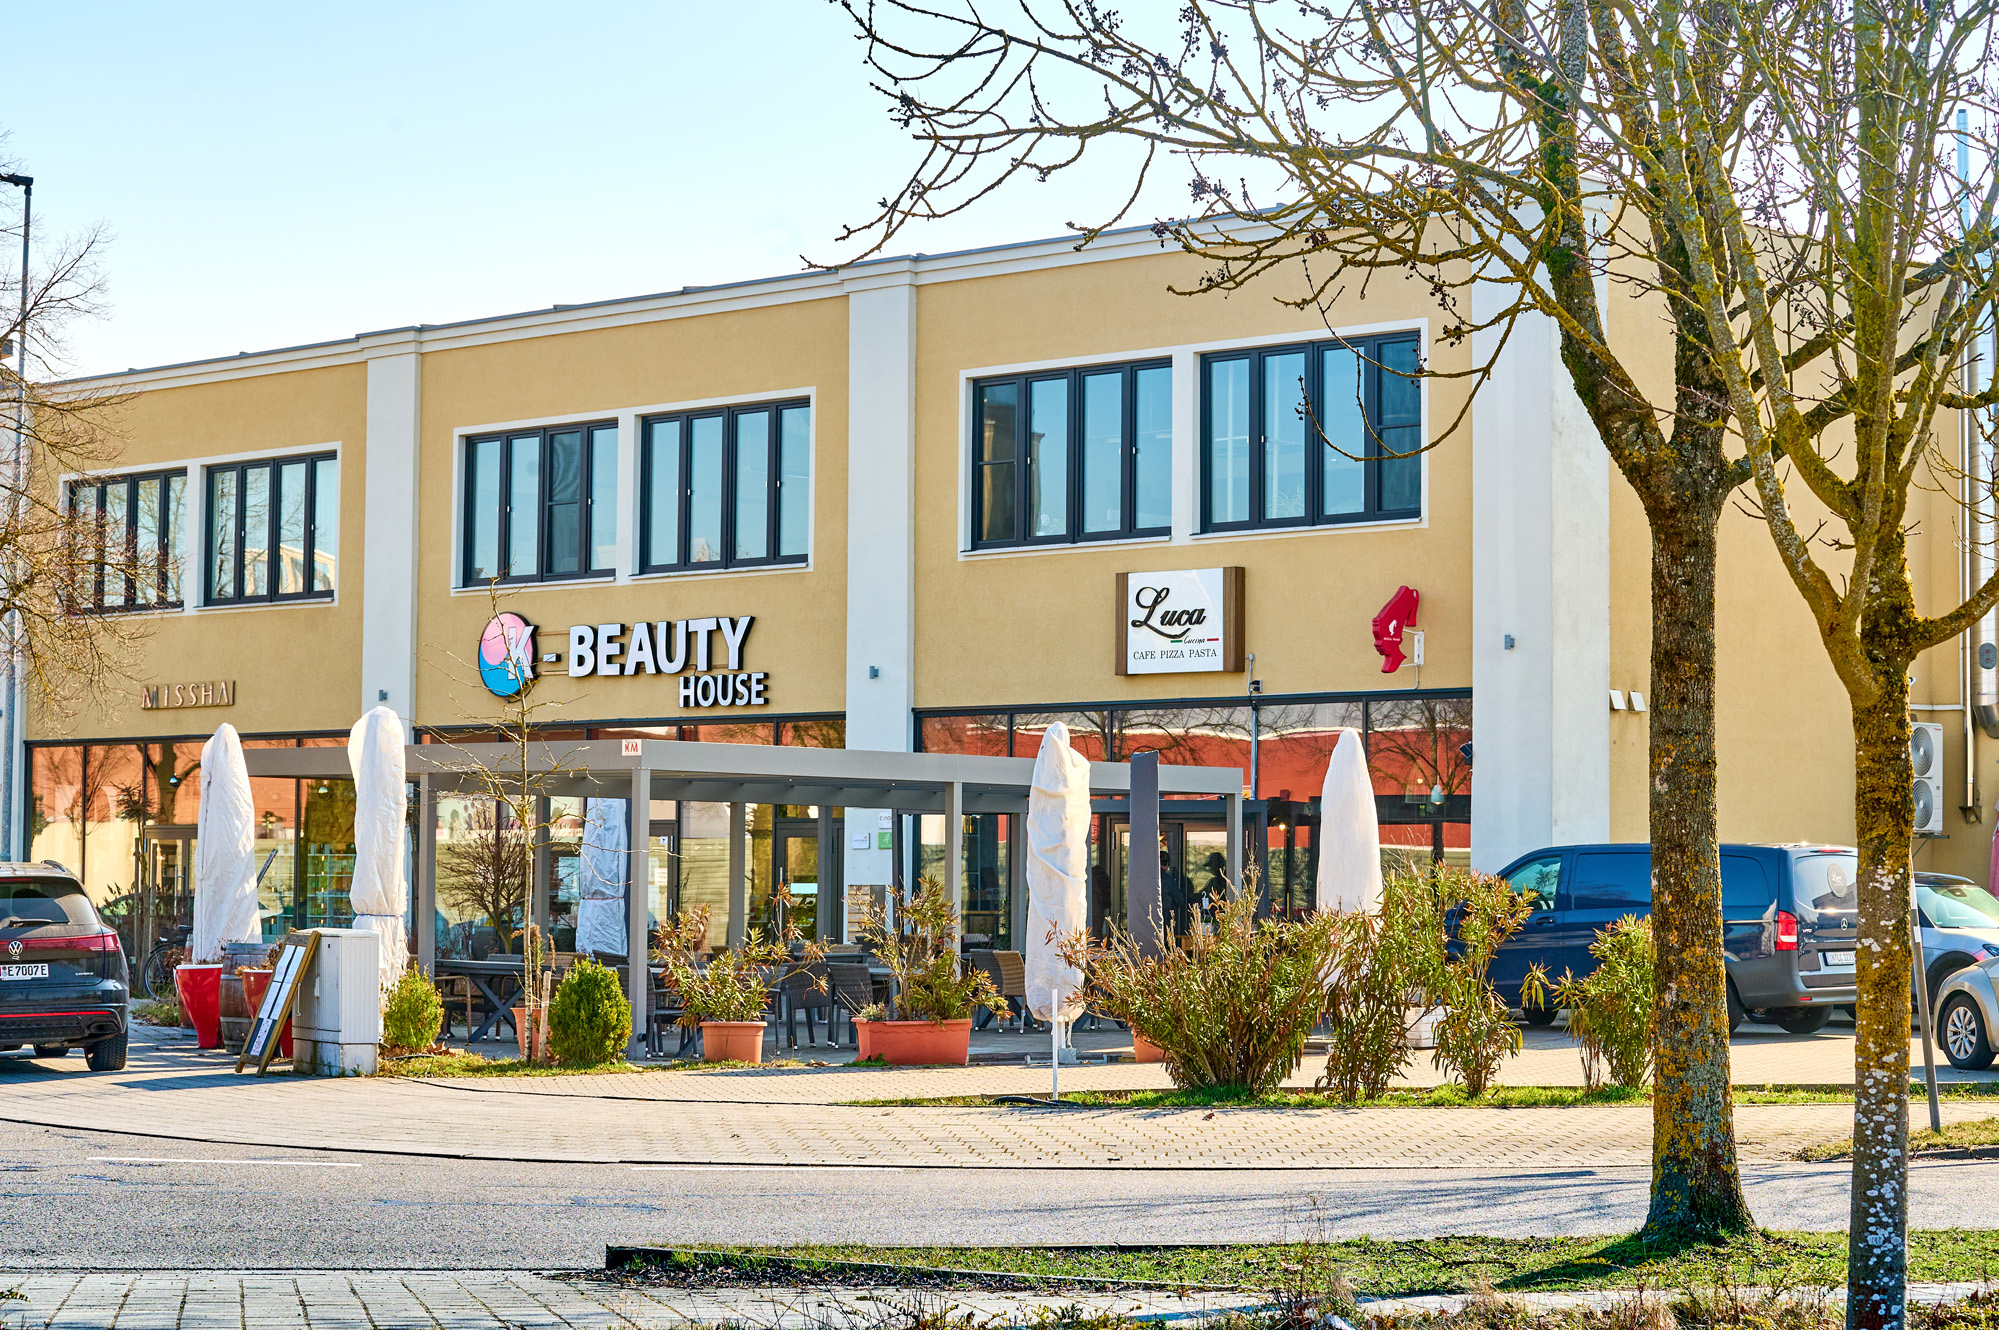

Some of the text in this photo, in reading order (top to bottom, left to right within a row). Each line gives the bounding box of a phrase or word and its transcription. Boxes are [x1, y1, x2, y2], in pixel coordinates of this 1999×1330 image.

[1131, 587, 1207, 639] Luca
[569, 616, 755, 678] BEAUTY
[1133, 648, 1217, 660] CAFE PIZZA PASTA
[141, 681, 230, 709] MISSHA
[679, 672, 769, 708] HOUSE
